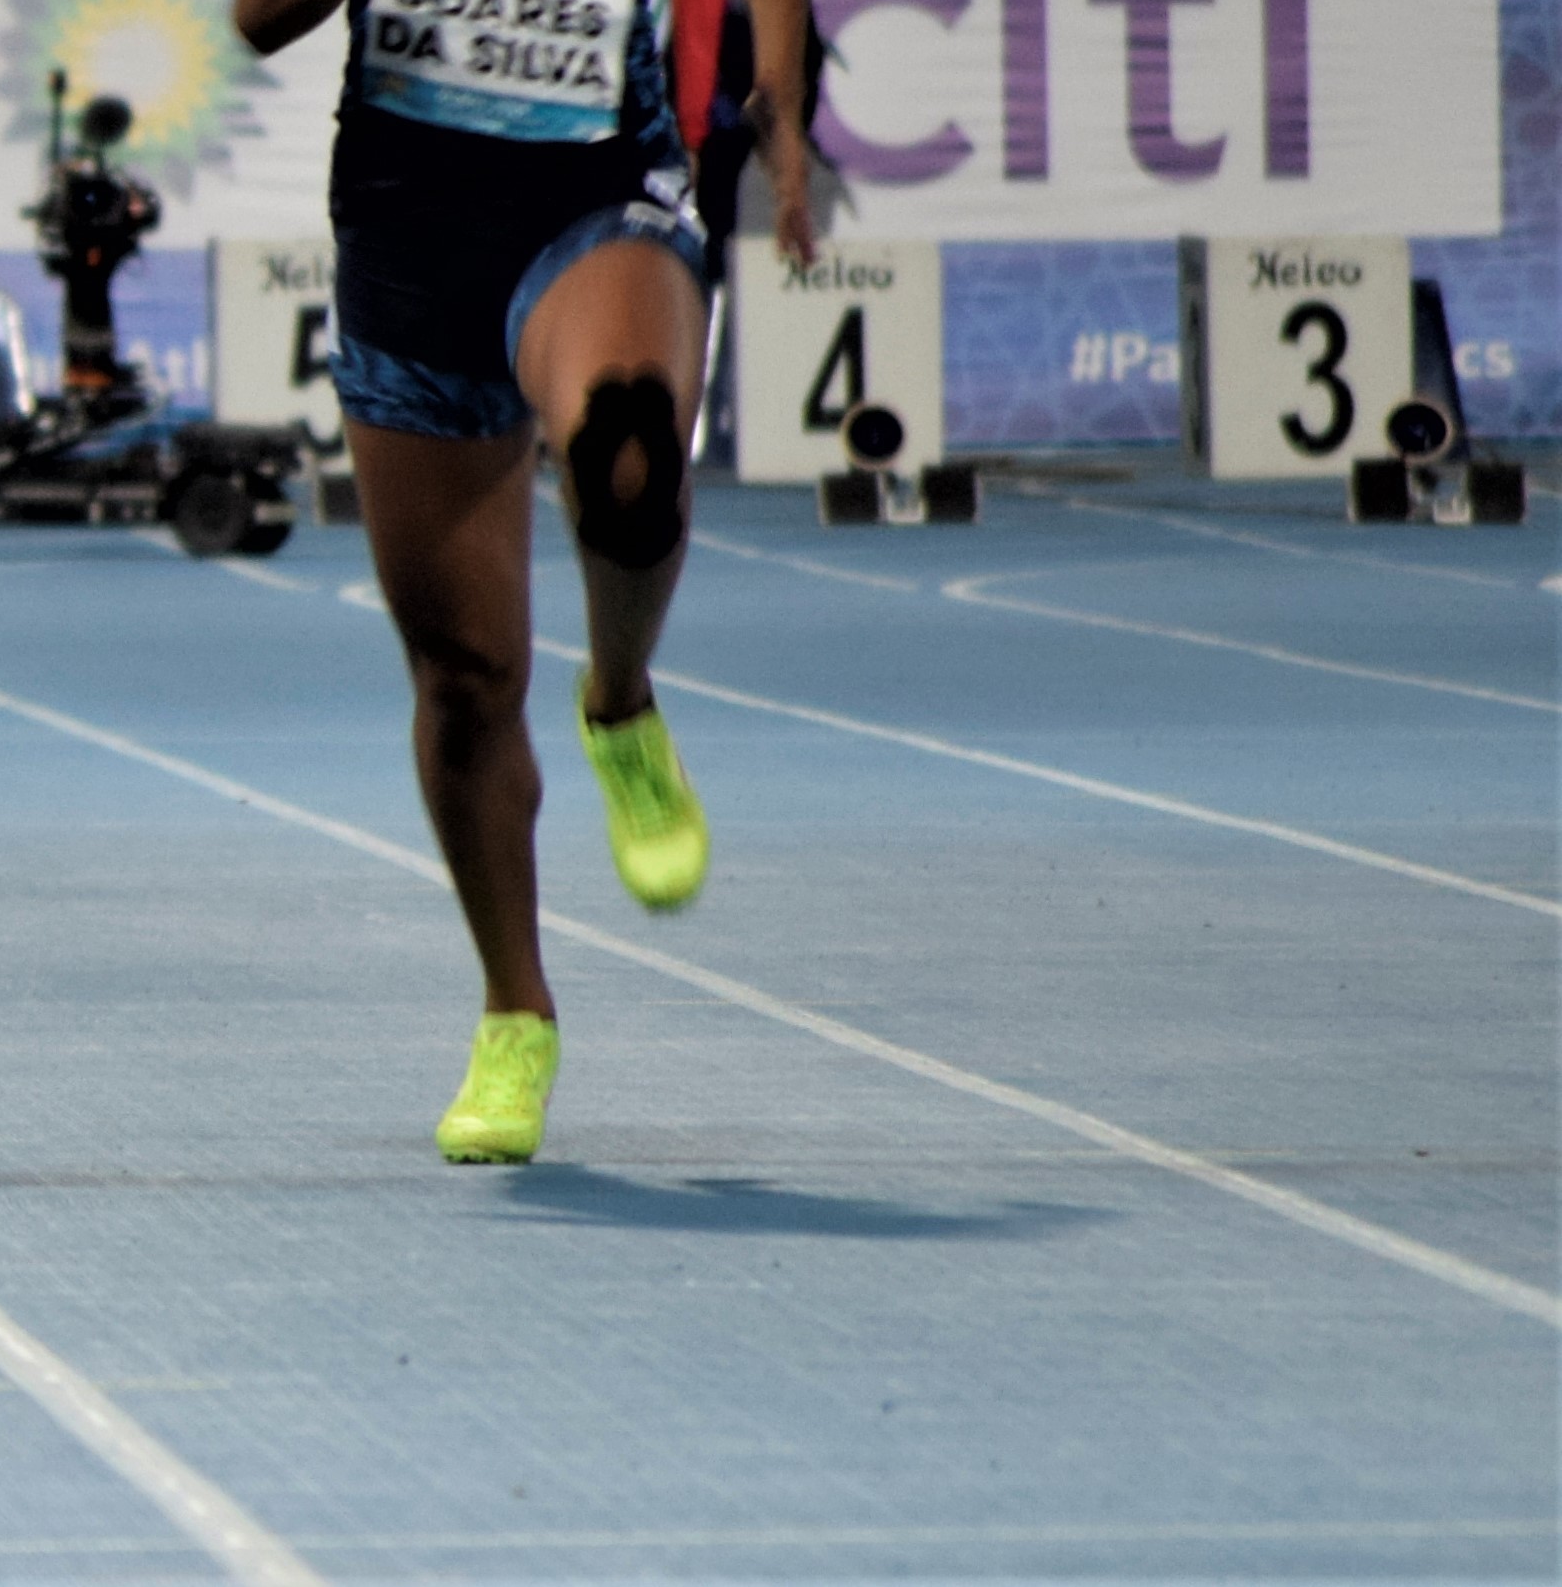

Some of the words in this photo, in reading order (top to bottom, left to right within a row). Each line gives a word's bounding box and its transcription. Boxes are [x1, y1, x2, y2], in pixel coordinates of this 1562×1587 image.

[375, 16, 448, 67] DA
[462, 33, 611, 90] SILVA
[802, 305, 866, 434] 4
[1279, 300, 1356, 457] 3
